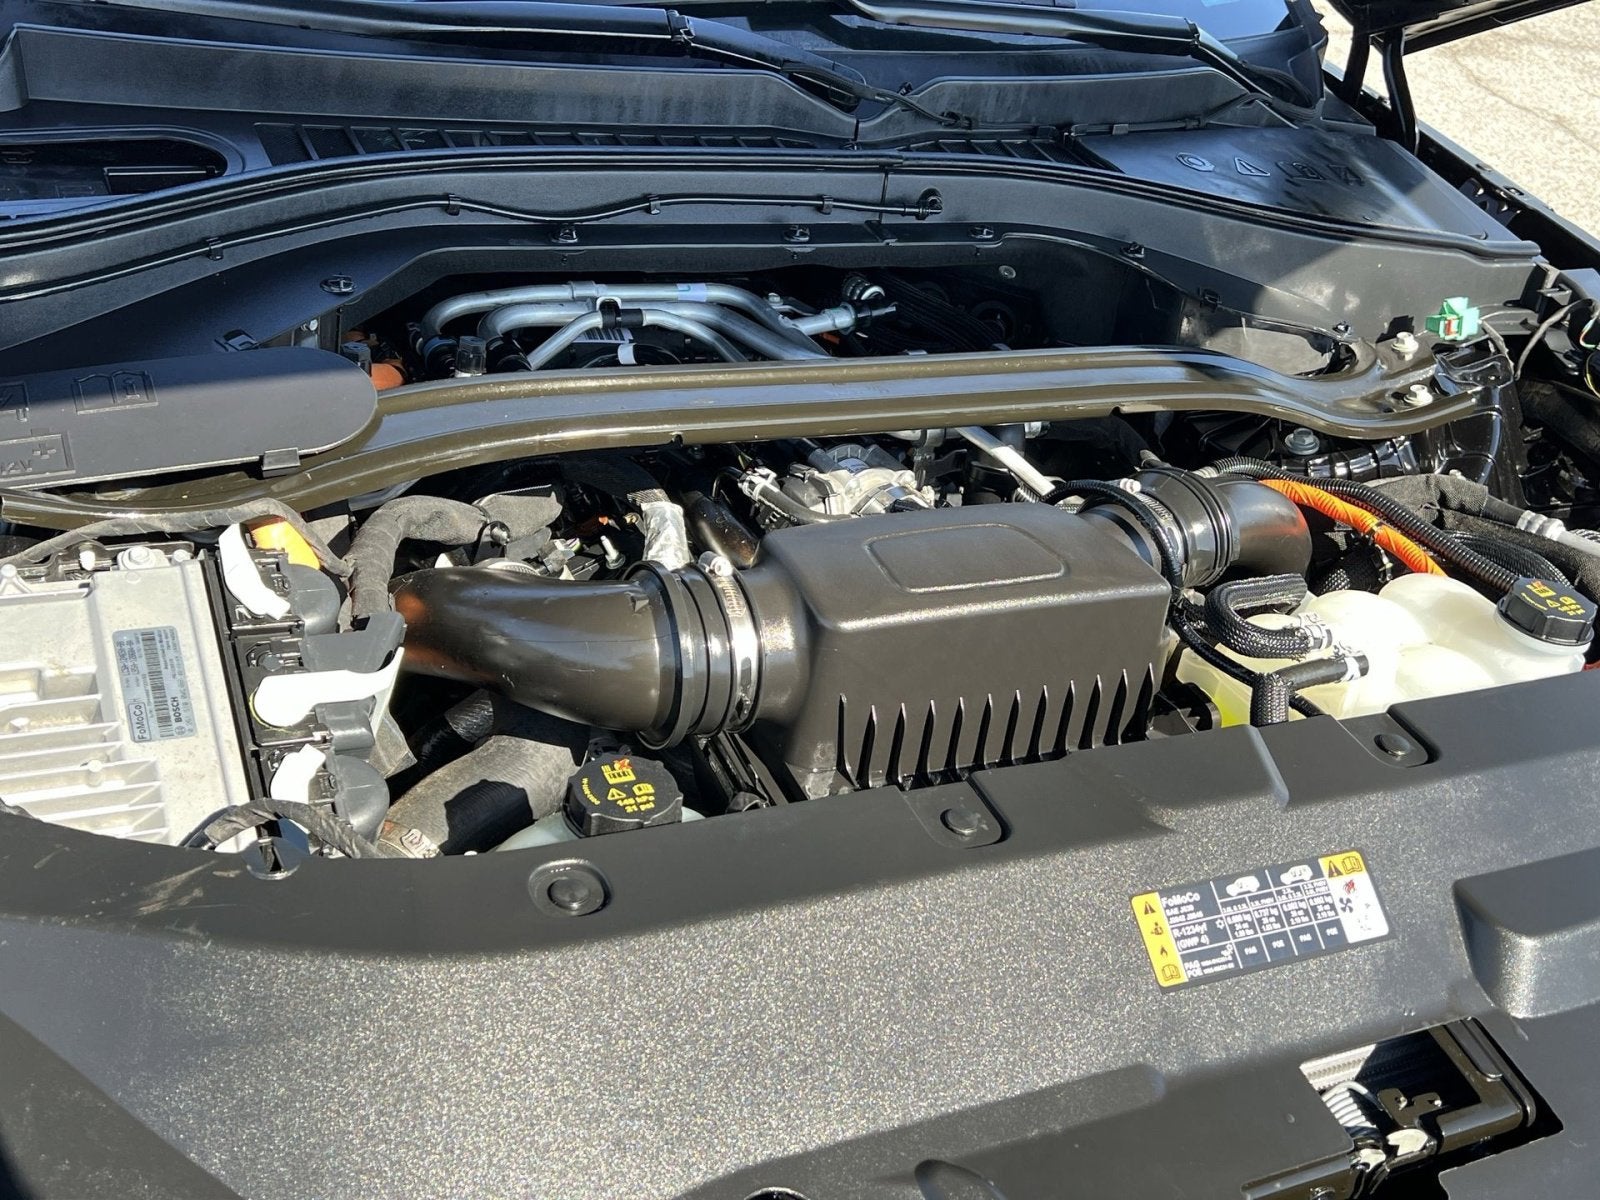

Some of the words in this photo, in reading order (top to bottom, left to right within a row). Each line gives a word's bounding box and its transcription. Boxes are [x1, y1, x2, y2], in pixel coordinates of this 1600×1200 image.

[134, 705, 147, 740] FoMoCo
[172, 697, 183, 723] BOSCH
[1161, 892, 1200, 908] FoMoCo
